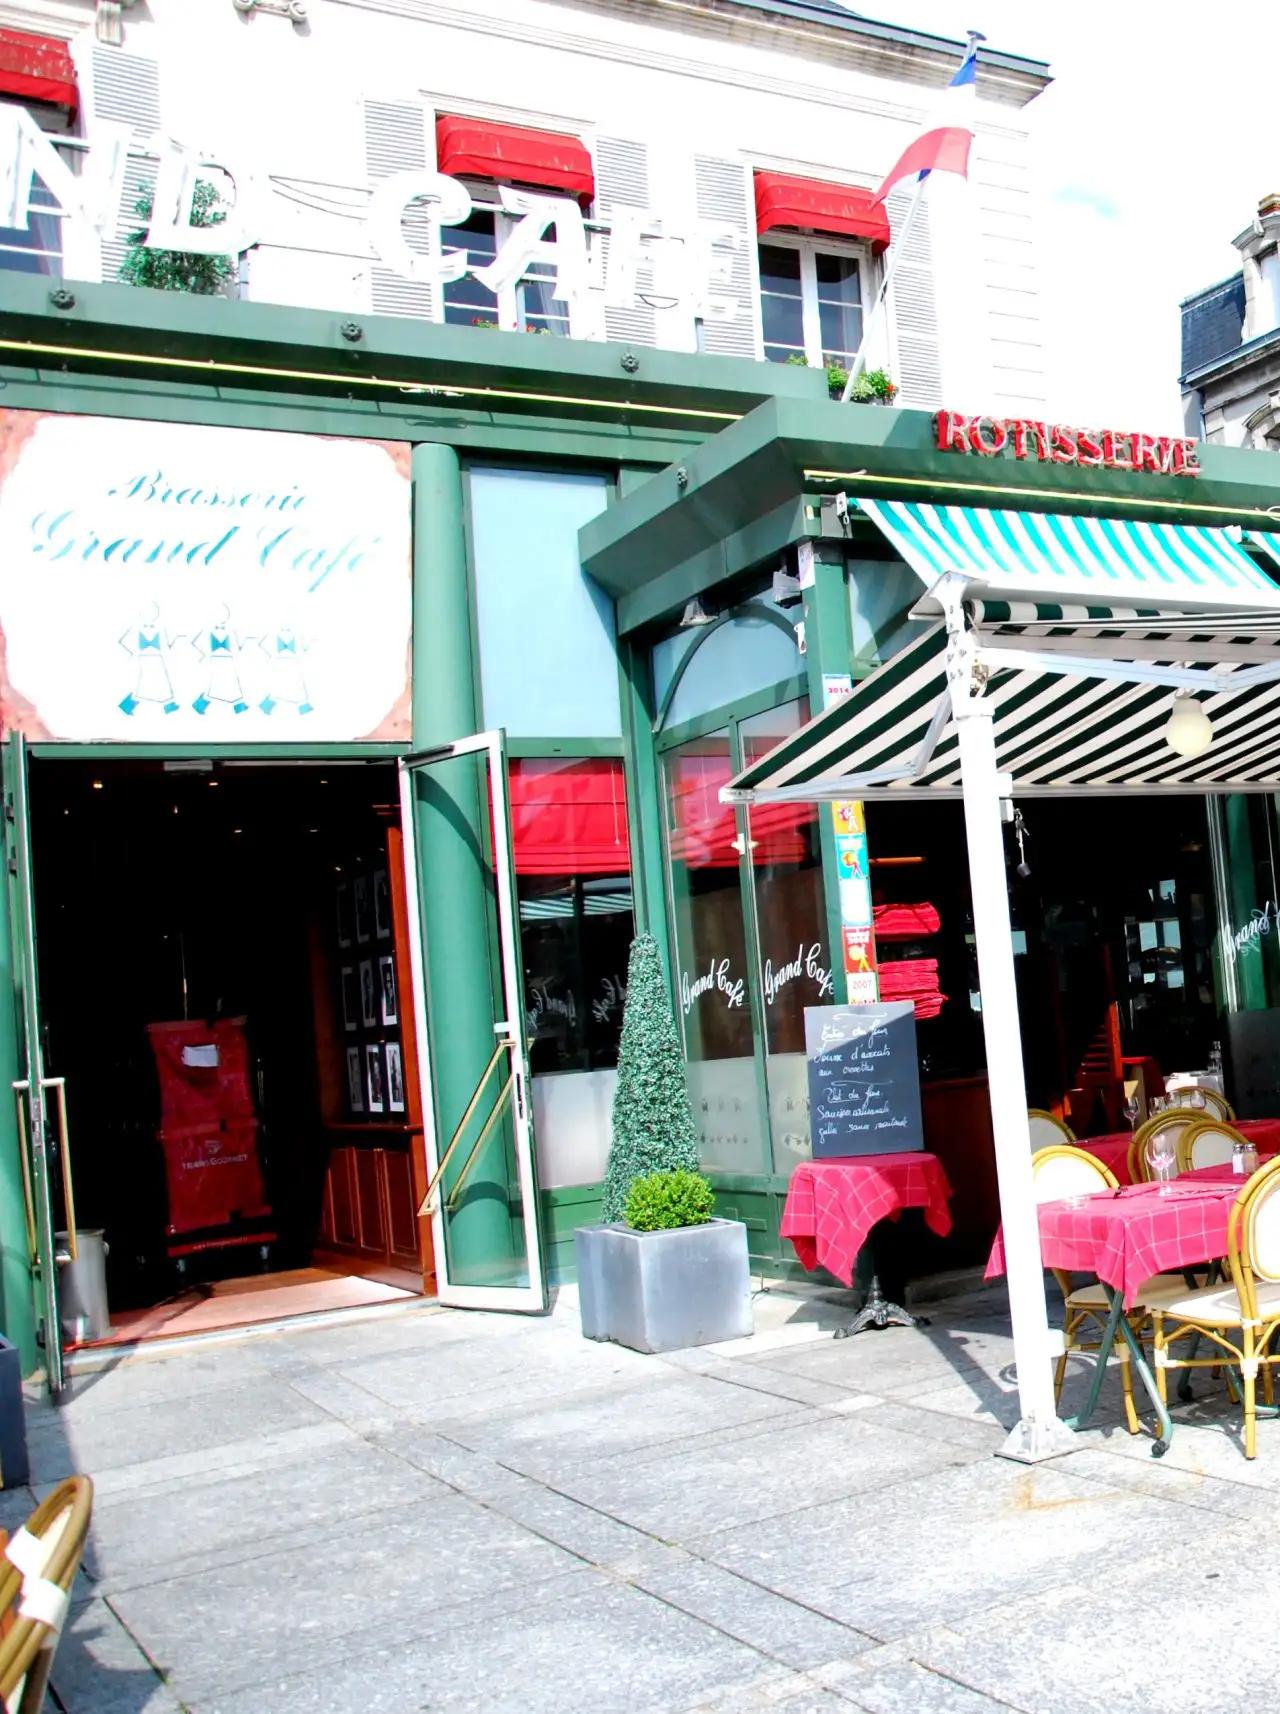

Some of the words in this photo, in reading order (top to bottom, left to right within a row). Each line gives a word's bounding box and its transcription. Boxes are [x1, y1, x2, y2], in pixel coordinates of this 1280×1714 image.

[933, 409, 1203, 477] ROTISSERIE
[30, 509, 241, 566] Grand
[255, 523, 384, 594] Café
[683, 958, 715, 1014] Grand
[765, 944, 803, 1005] Grand
[852, 980, 872, 989] 2007
